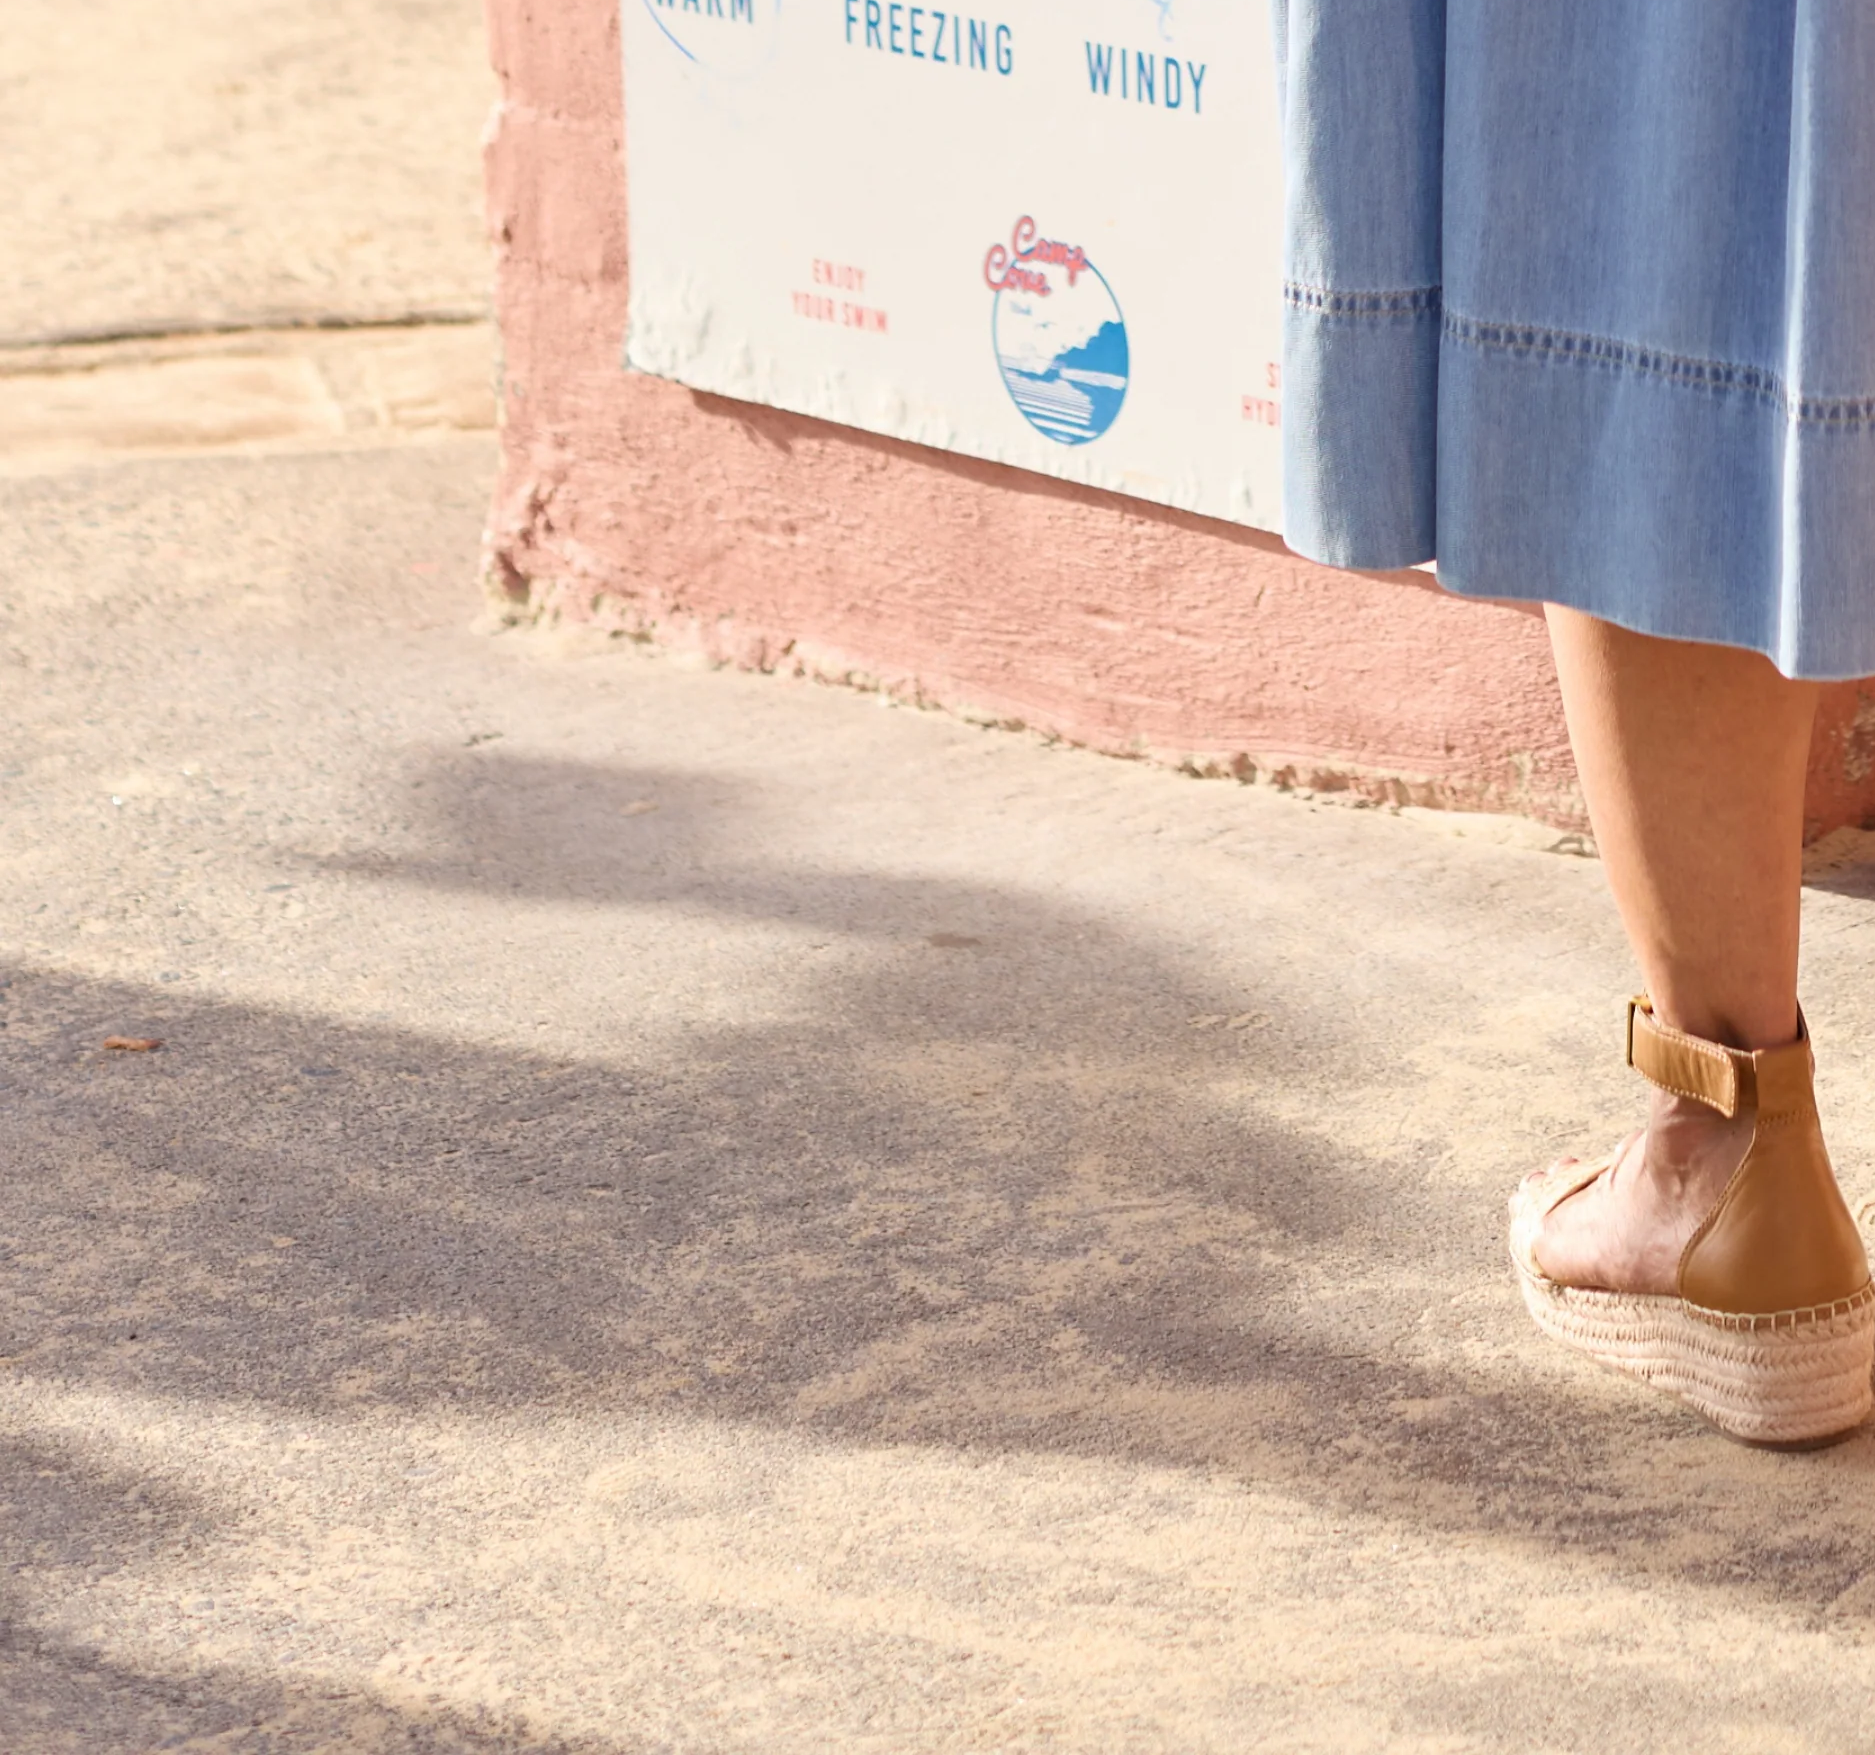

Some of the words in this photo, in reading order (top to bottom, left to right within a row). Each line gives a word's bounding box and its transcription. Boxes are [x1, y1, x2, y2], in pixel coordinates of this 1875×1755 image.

[1086, 42, 1207, 114] WINDY
[813, 257, 866, 292] ENJOY
[984, 243, 1052, 297] Cove
[1012, 215, 1089, 287] Camp
[792, 290, 836, 323] YOUR
[842, 302, 888, 334] SWIM
